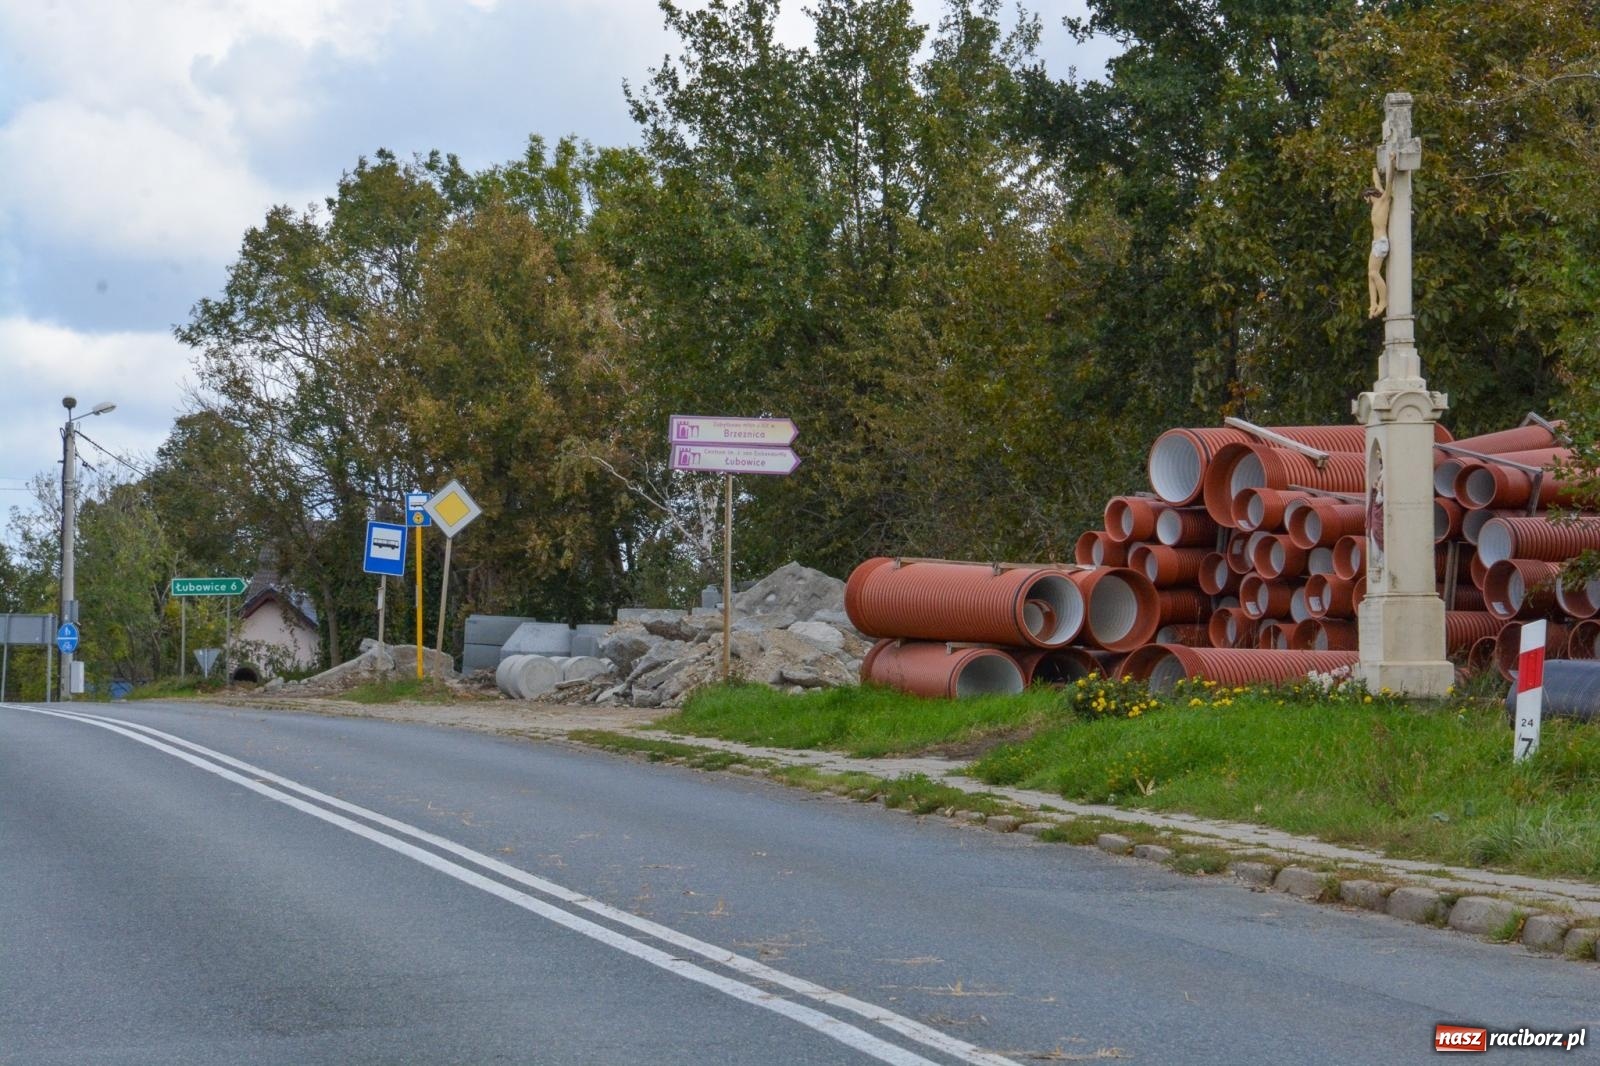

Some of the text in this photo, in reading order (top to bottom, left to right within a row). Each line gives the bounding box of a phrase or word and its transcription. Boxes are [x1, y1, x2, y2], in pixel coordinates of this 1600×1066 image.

[725, 457, 766, 466] Łubowice
[175, 581, 238, 592] Łubowice 6
[1521, 718, 1534, 728] 24
[1520, 737, 1534, 758] 7
